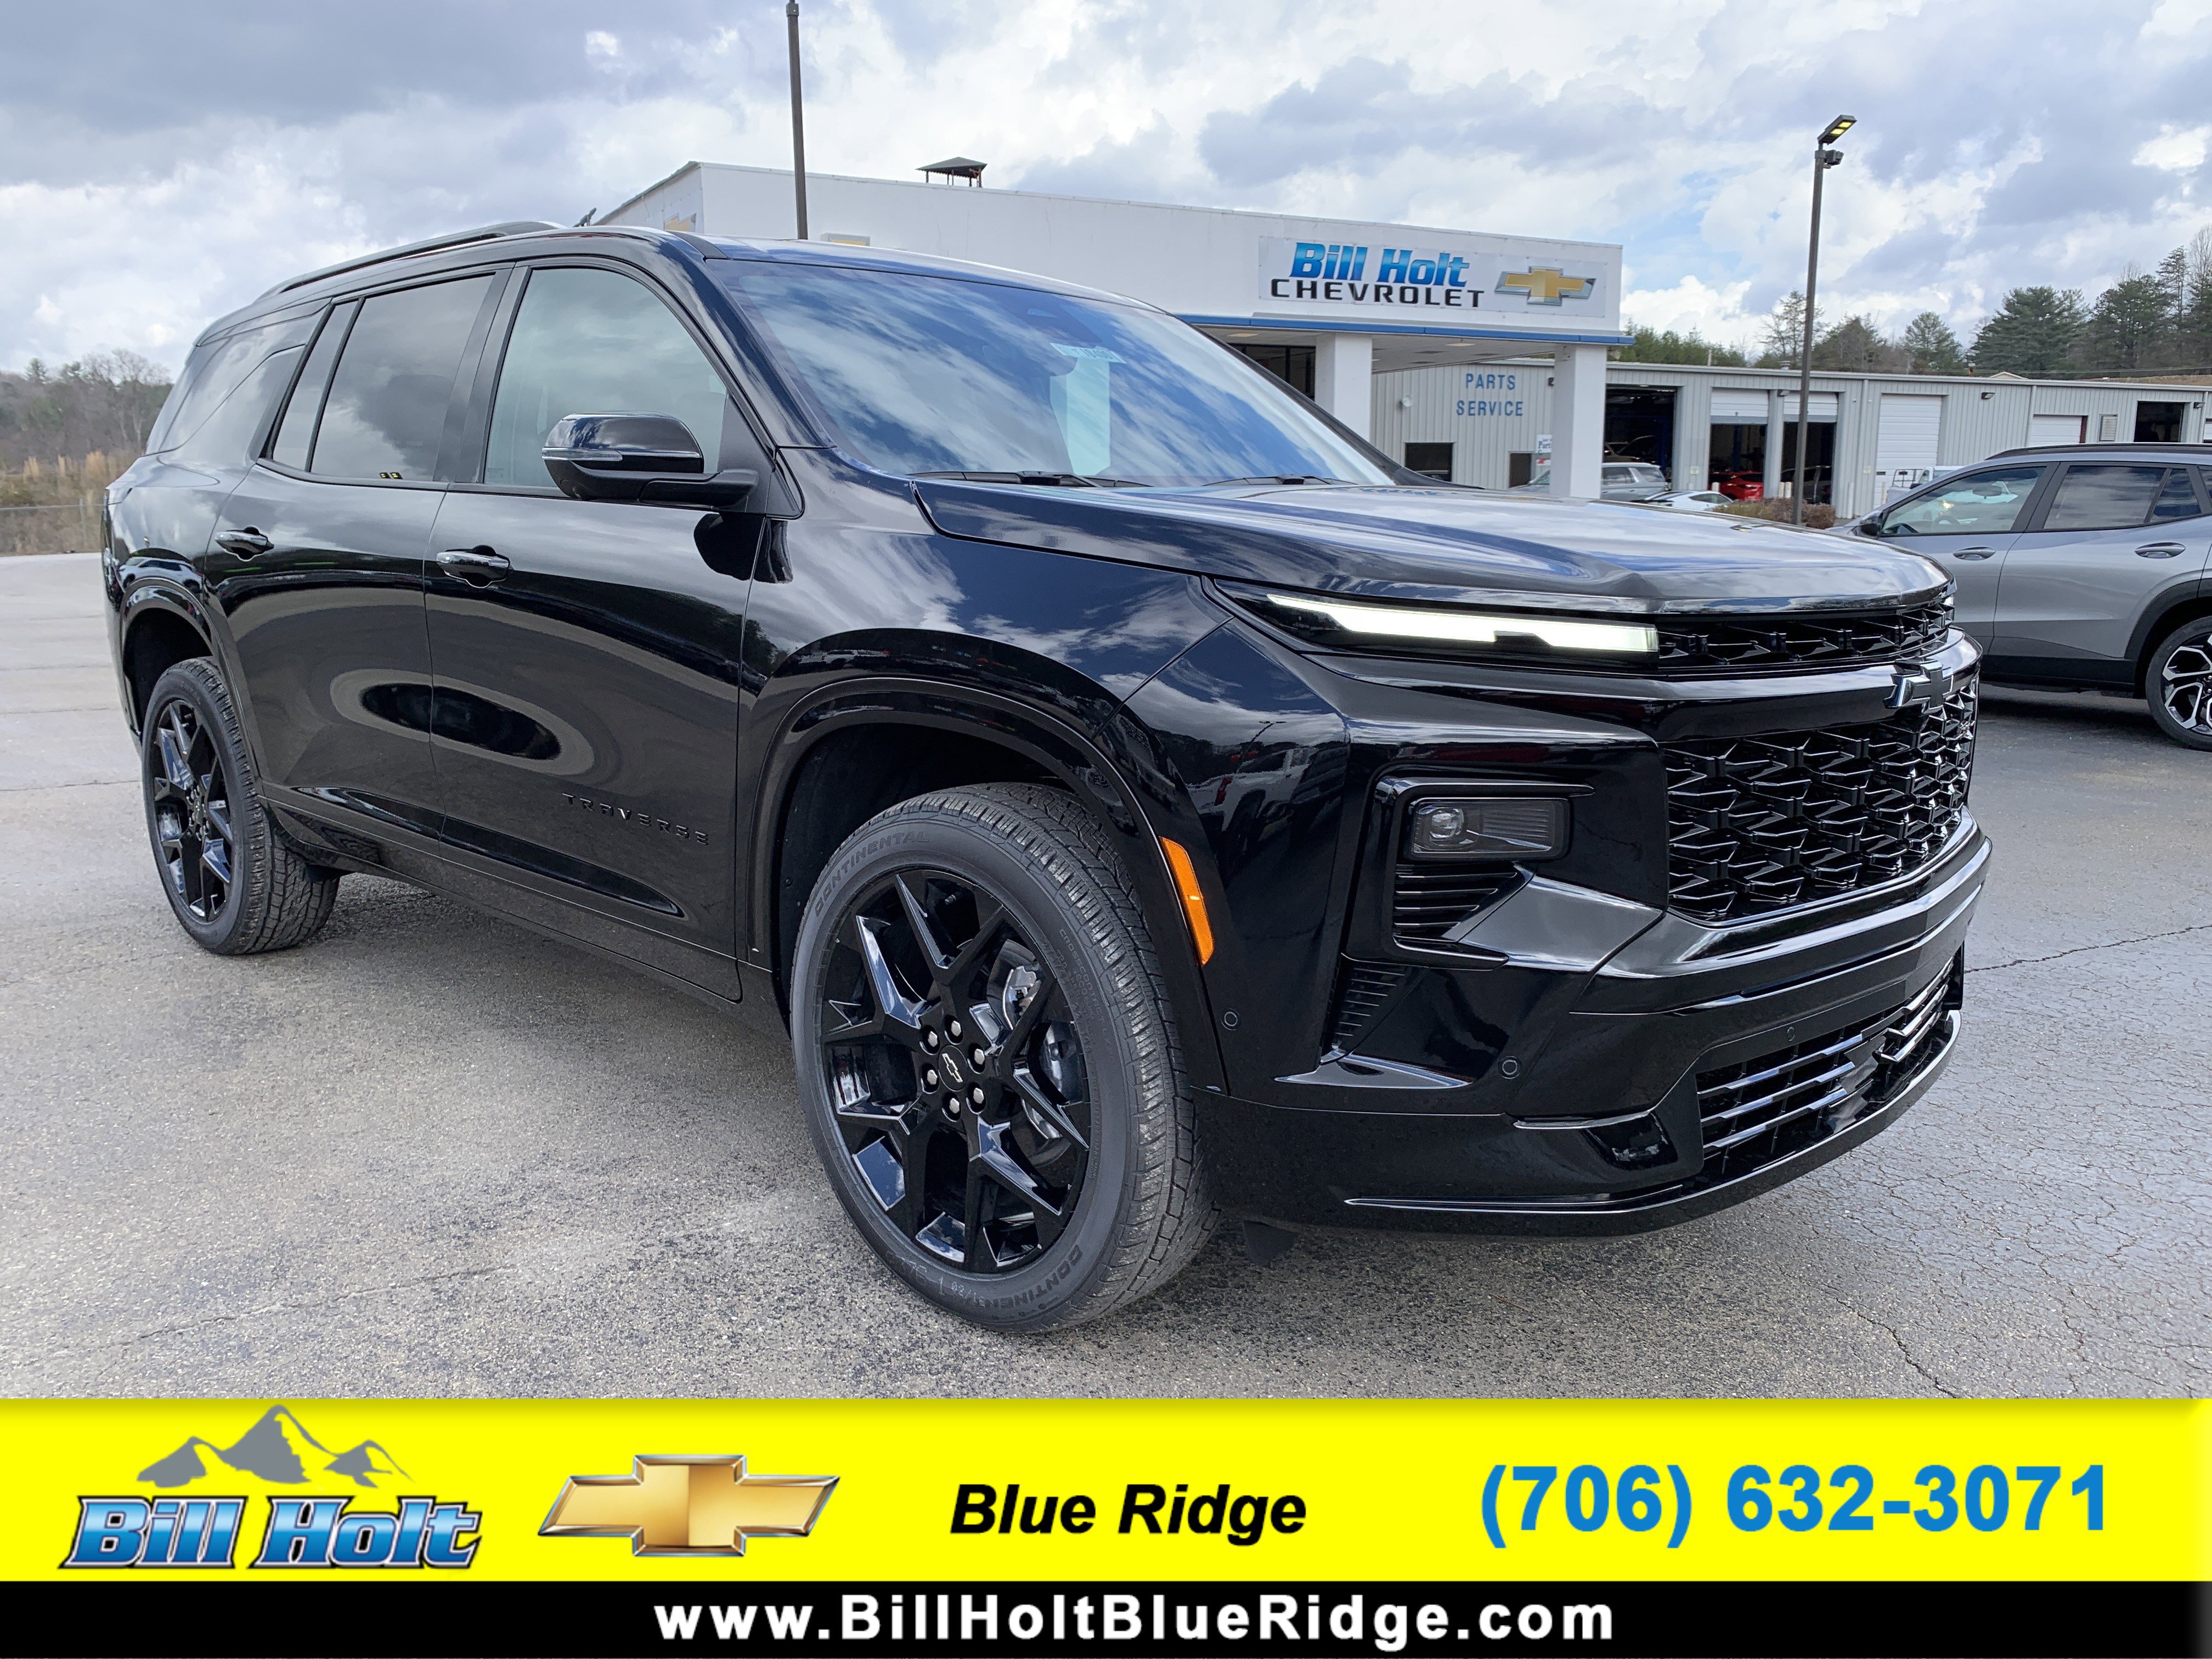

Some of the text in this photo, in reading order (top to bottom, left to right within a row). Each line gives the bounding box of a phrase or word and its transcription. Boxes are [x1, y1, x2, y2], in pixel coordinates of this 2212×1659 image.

[1289, 242, 1470, 288] Bill Holt
[1271, 278, 1485, 308] CHEVROLET
[1465, 373, 1516, 390] PARTS
[1457, 399, 1523, 416] SERVICE
[562, 792, 709, 846] TRAVERSE
[815, 832, 931, 918] CONTINENTAL
